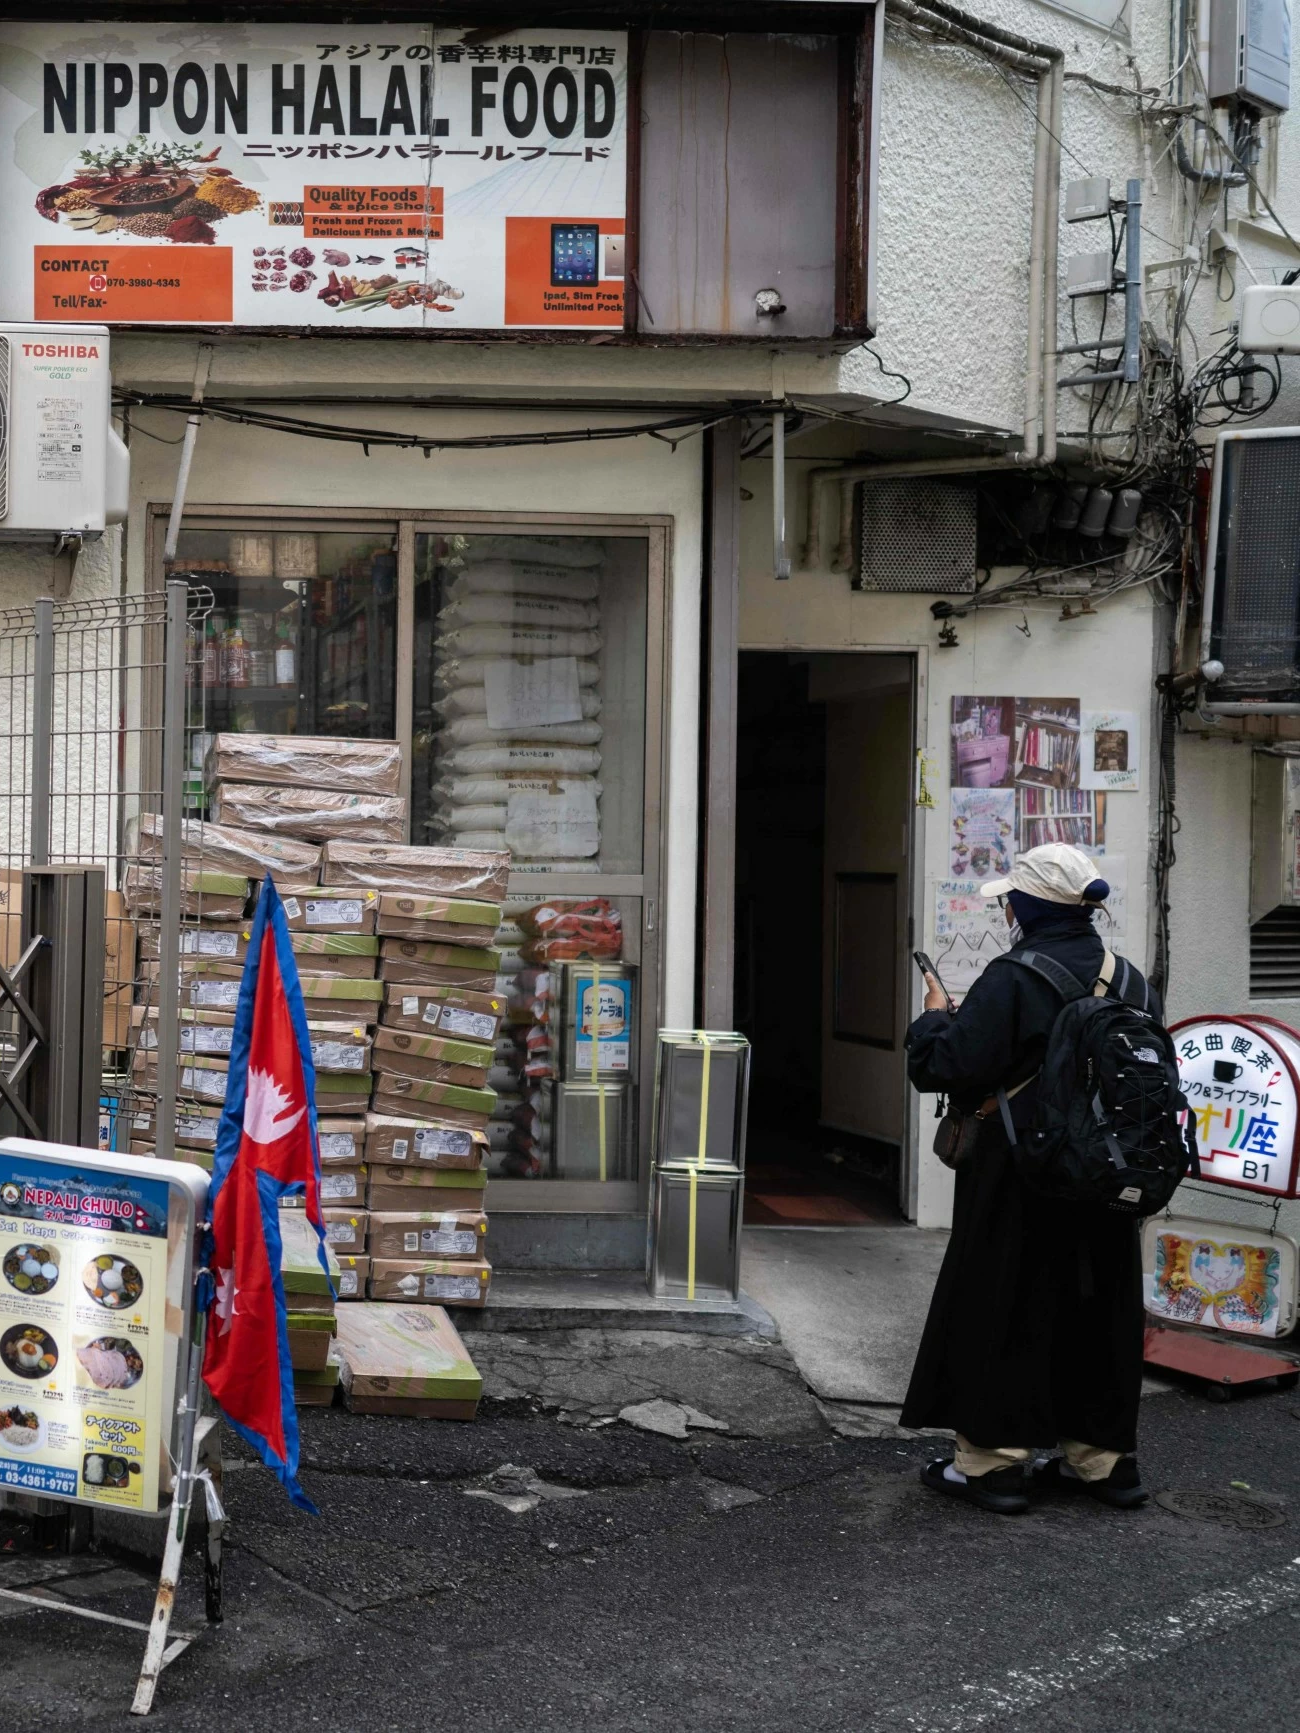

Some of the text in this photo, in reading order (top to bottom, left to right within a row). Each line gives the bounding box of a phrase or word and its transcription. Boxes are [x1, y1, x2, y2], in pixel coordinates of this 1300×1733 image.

[316, 45, 616, 65] アジアの香辛料専門店
[43, 62, 616, 139] NIPPON HALAL FOOD
[244, 144, 610, 162] ニッポンハラールフード
[309, 188, 418, 205] Quality Foods
[312, 217, 403, 225] Fresh and Frozen
[312, 228, 361, 236] Delicious
[364, 228, 392, 236] Fishs
[41, 260, 109, 272] CONTACT
[107, 278, 181, 288] 070-3980-4343
[53, 295, 107, 308] Tell/Fax-
[544, 292, 619, 301] Ipad, Sim Free
[544, 303, 594, 311] Unlimited
[22, 344, 99, 359] TOSHIBA
[49, 372, 71, 380] GOLD
[584, 1004, 623, 1018] キノーラ油
[1180, 1033, 1274, 1073] 名曲喫茶
[1242, 1160, 1270, 1182] B1
[25, 1187, 77, 1211] NEPALI
[81, 1196, 134, 1218] CHULO
[43, 1210, 112, 1229] ネパーリチュロ
[23, 1223, 57, 1239] Menu
[86, 1416, 141, 1434] テイクアウト
[85, 1439, 108, 1447] Takeout
[99, 1430, 126, 1443] セット
[27, 1467, 46, 1475] 11:00
